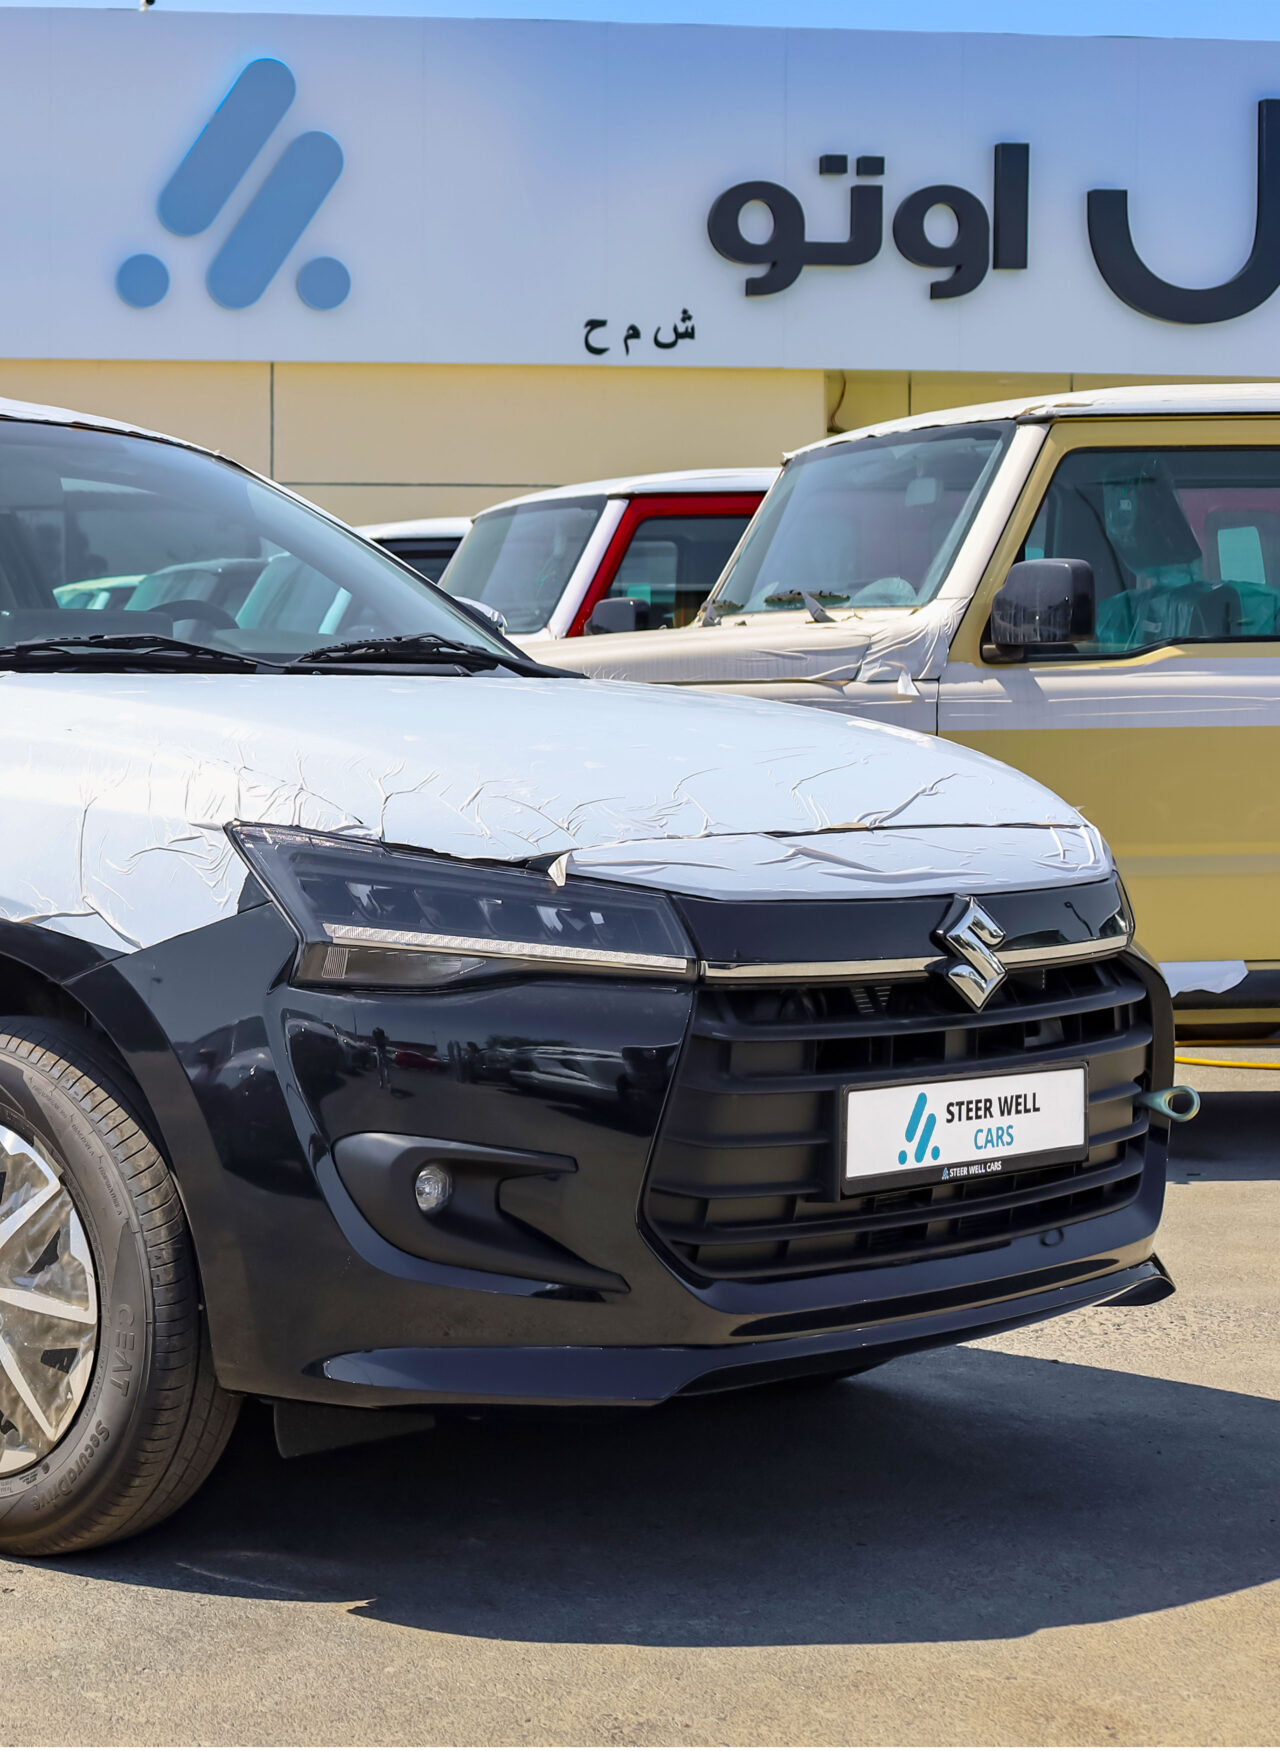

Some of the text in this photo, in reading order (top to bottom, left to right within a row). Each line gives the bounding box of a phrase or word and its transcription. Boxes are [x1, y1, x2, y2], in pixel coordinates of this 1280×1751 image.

[708, 142, 1030, 299] اوتو
[946, 1092, 1041, 1124] STEER WELL
[974, 1124, 1014, 1150] CARS
[949, 1160, 1002, 1177] STEER WELL CARS
[110, 1303, 136, 1398] CEAT
